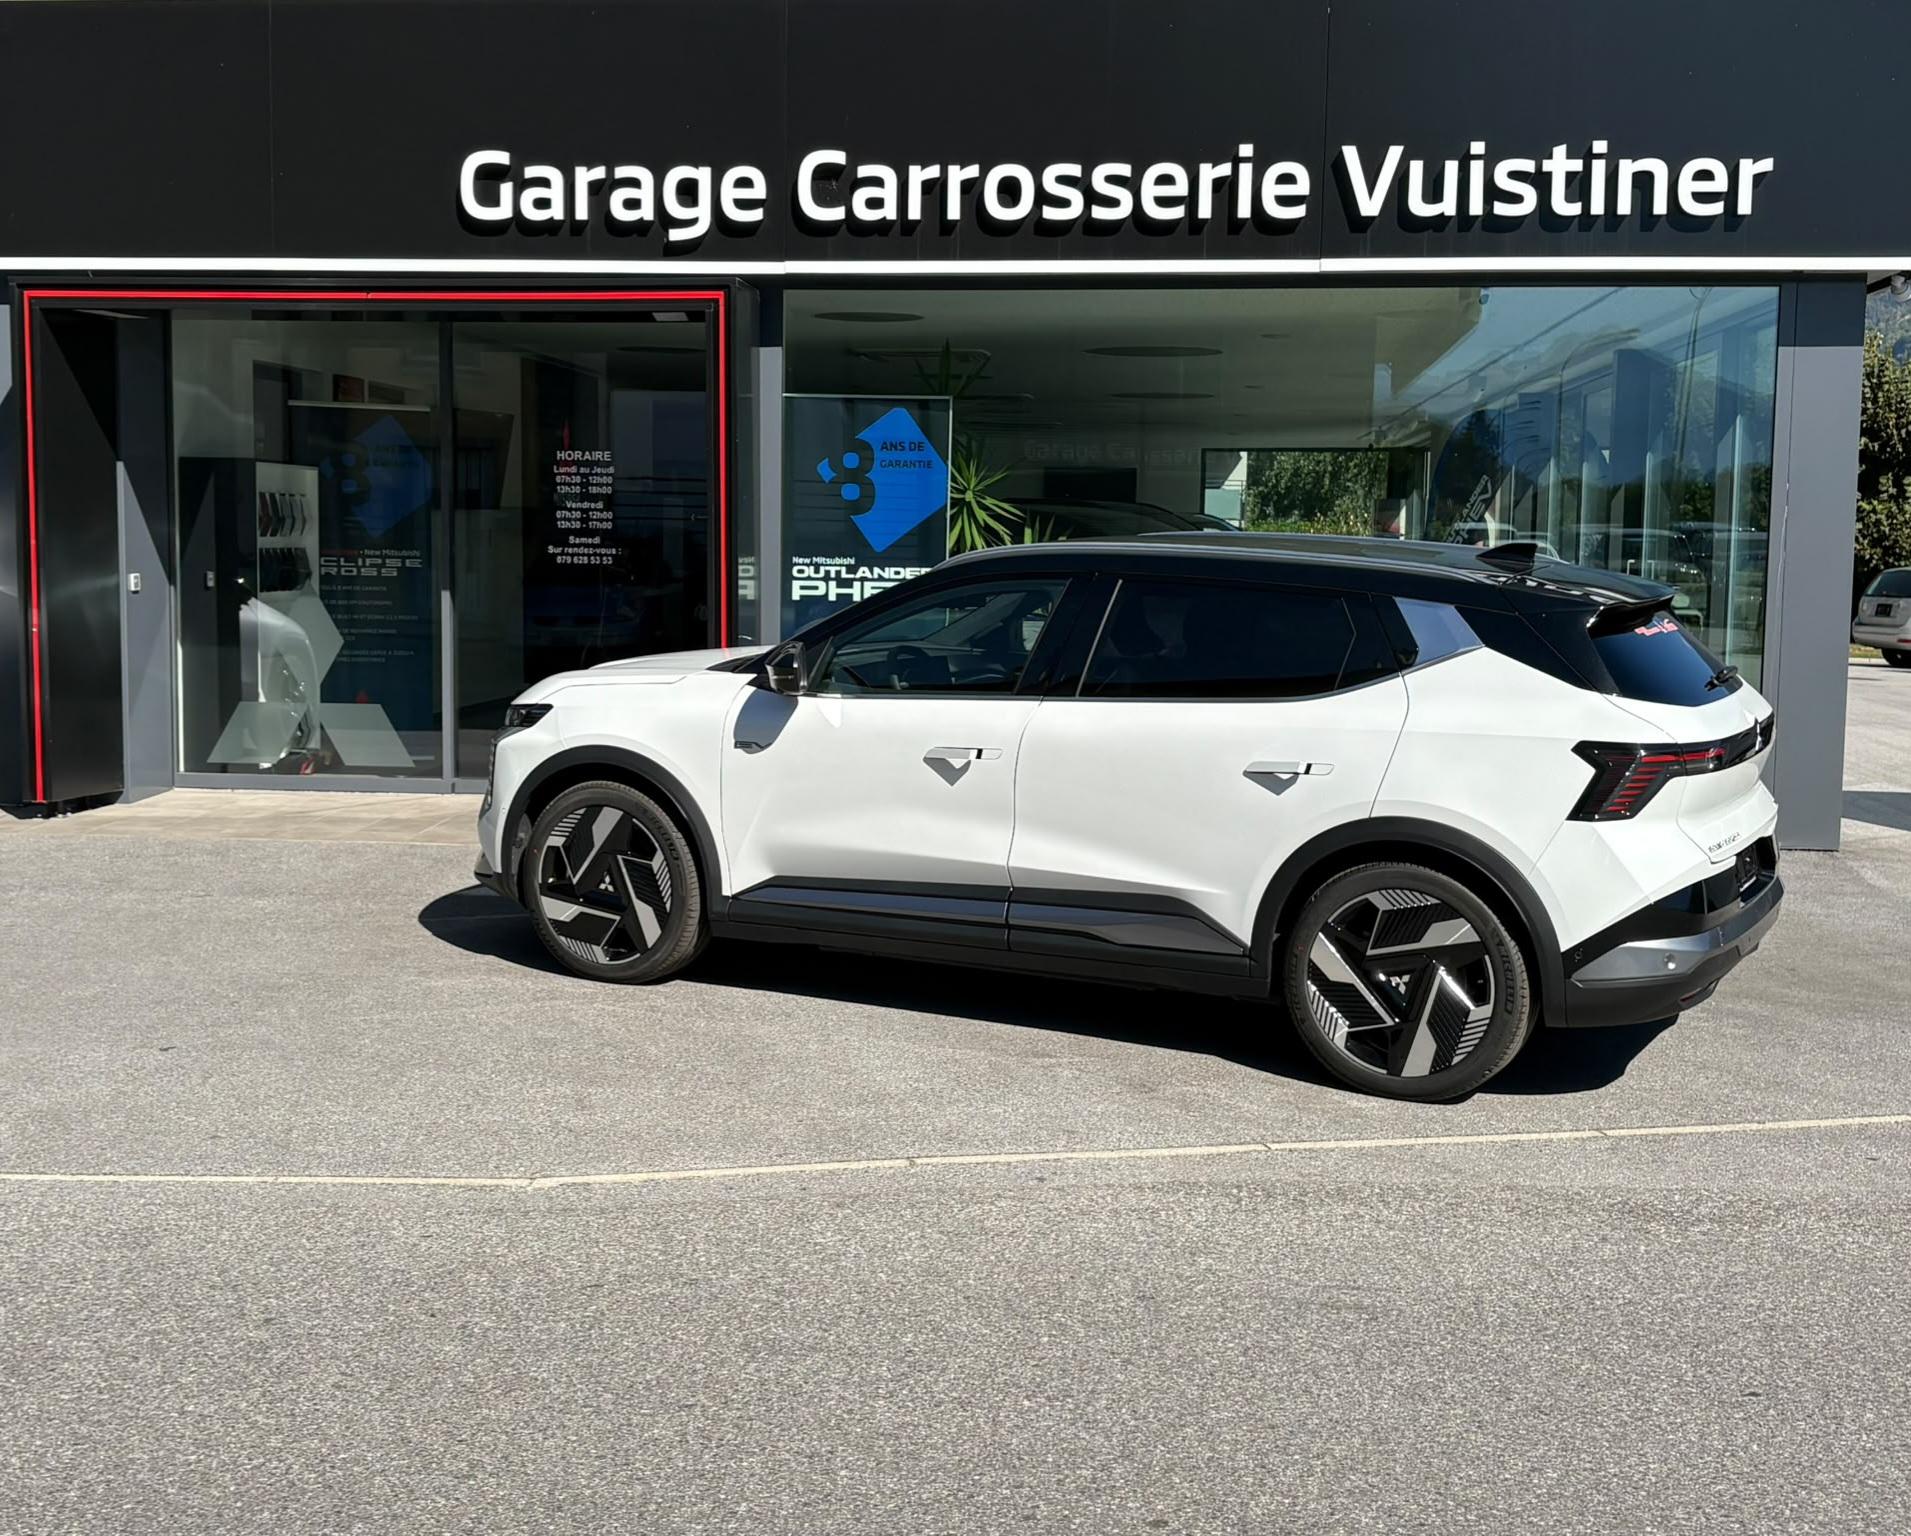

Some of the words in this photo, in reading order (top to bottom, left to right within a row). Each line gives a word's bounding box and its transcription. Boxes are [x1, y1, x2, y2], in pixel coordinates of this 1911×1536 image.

[459, 149, 767, 241] Garage
[796, 143, 1311, 222] Carrosserie
[1341, 140, 1774, 218] Vuistiner
[880, 441, 905, 452] ANS
[908, 441, 925, 452] DE
[556, 450, 612, 461] HORAIRE
[880, 459, 934, 469] GARANTIE
[553, 465, 577, 473] Lundi
[591, 465, 615, 474] Jeudi
[555, 475, 581, 483] 07h30
[588, 476, 613, 484] 12h00
[556, 485, 581, 493] 13h30
[588, 486, 612, 494] 18h00
[565, 500, 604, 509] Vendredi
[555, 510, 581, 518] 07h30
[588, 511, 613, 519] 12h00
[556, 520, 581, 528] 13h30
[588, 521, 612, 529] 17h00
[568, 535, 601, 544] Samedi
[547, 545, 563, 553] Sur
[564, 546, 616, 554] rendez-vous
[320, 557, 423, 568] CLIPSE
[556, 555, 572, 563] 079
[590, 556, 601, 564] 53
[602, 556, 613, 564] 53
[792, 556, 811, 565] New
[812, 556, 856, 565] Mitsubishi
[320, 567, 399, 577] ROSS
